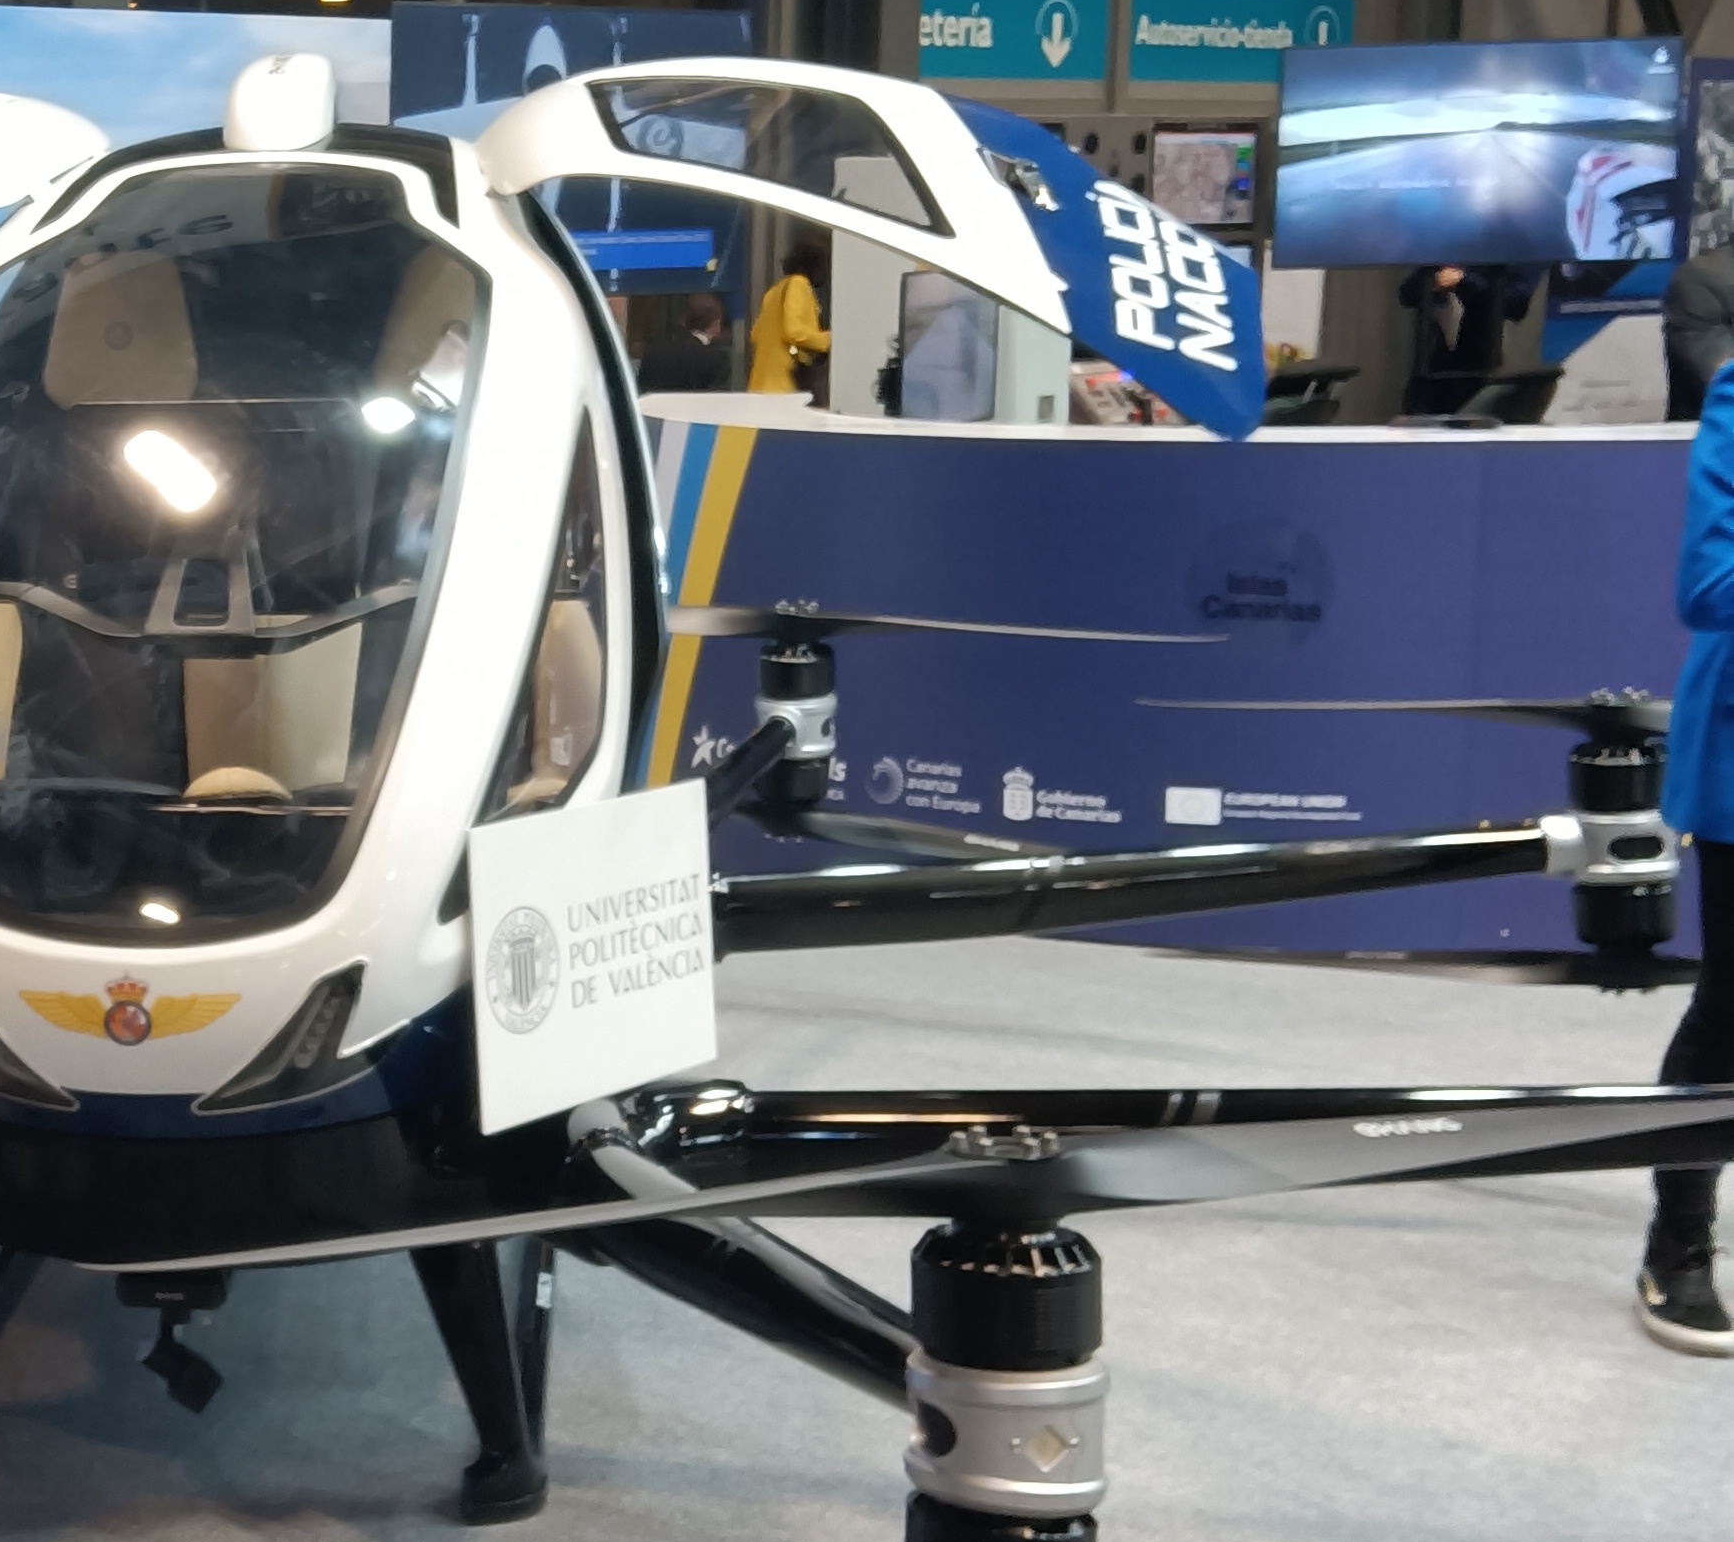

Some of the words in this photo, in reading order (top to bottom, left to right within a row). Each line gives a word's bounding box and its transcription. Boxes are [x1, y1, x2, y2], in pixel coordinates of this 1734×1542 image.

[566, 872, 702, 933] UNIVERSITAT
[568, 913, 704, 971] POLITÈCNICA
[570, 974, 599, 1009] DE
[608, 947, 706, 997] VALÈNCIA
